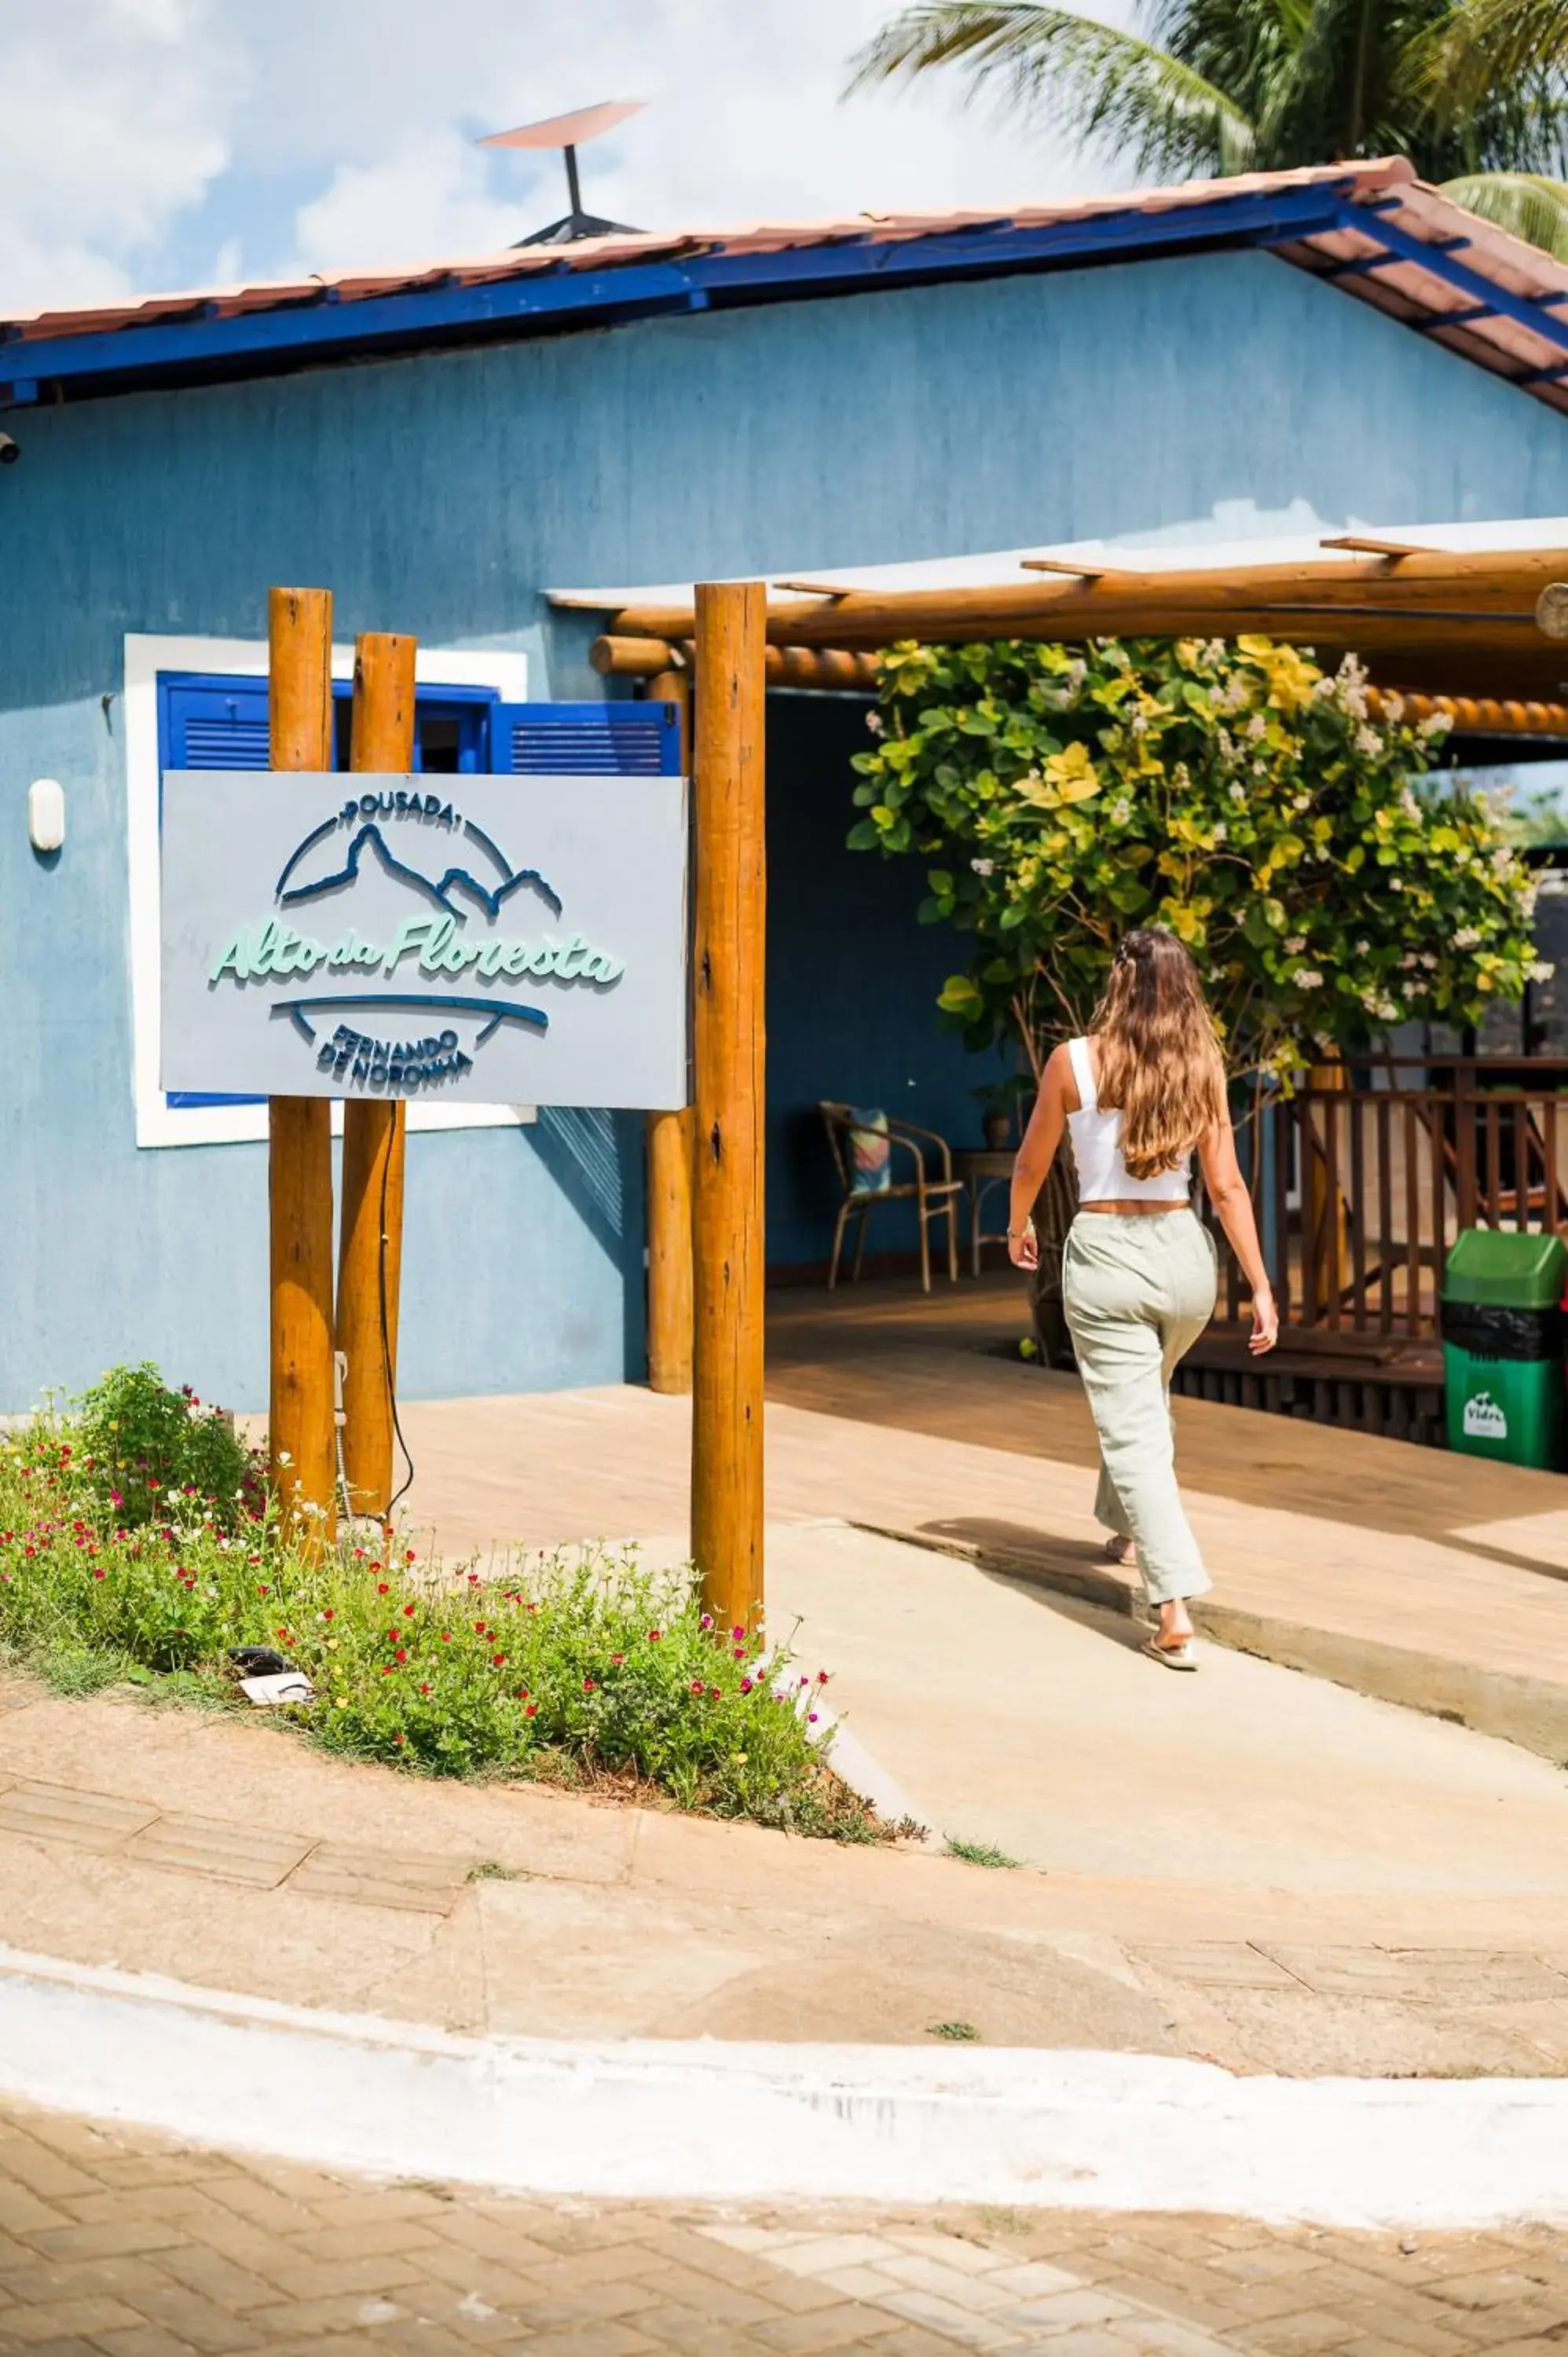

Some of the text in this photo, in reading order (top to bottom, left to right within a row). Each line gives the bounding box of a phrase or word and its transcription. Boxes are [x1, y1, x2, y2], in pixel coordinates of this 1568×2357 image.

[343, 791, 454, 825] POUSADA
[208, 911, 625, 984] Alto da Floresta
[333, 1024, 459, 1061] FERNANDO
[317, 1042, 474, 1084] DE NORONHA
